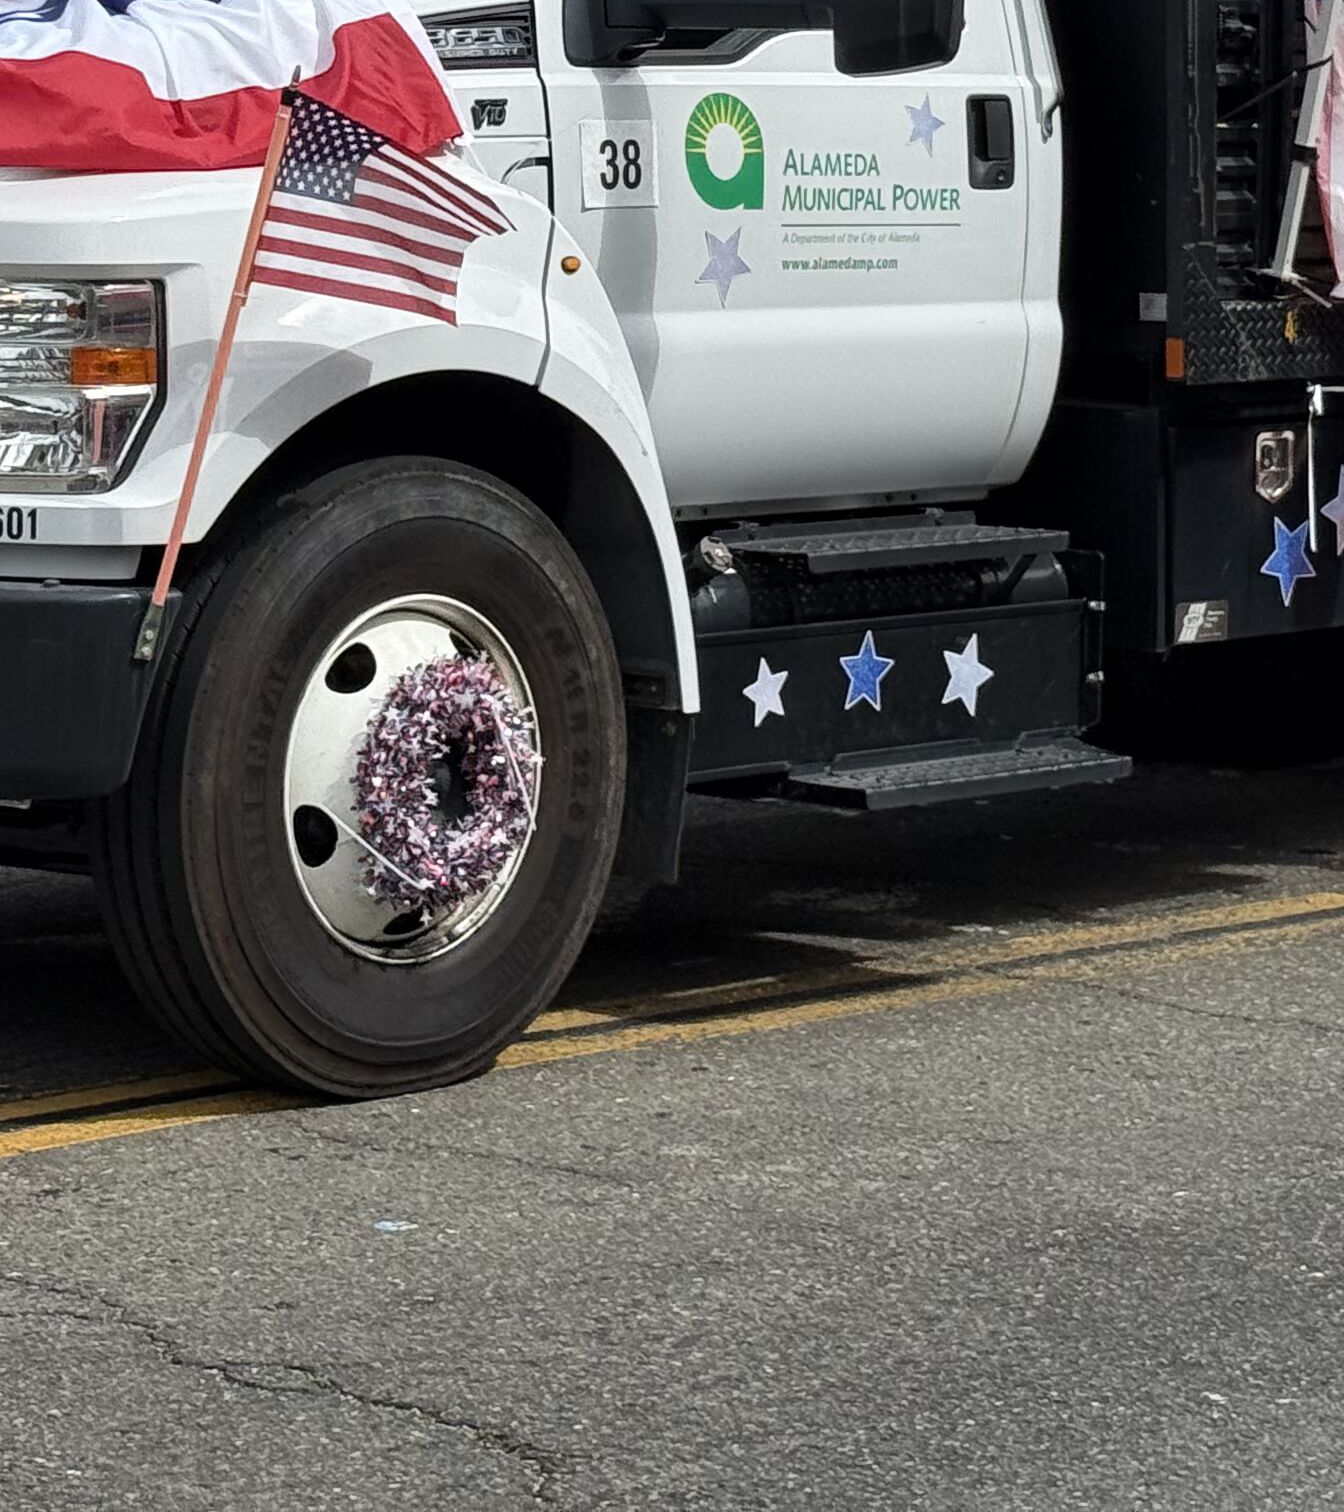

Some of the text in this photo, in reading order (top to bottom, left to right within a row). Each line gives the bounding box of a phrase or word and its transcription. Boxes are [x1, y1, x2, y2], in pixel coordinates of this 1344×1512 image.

[599, 138, 642, 191] 38
[782, 148, 881, 177] ALAMEDA
[782, 184, 961, 212] MUNICIPAL POWER
[781, 256, 898, 273] www.alamedamp.com
